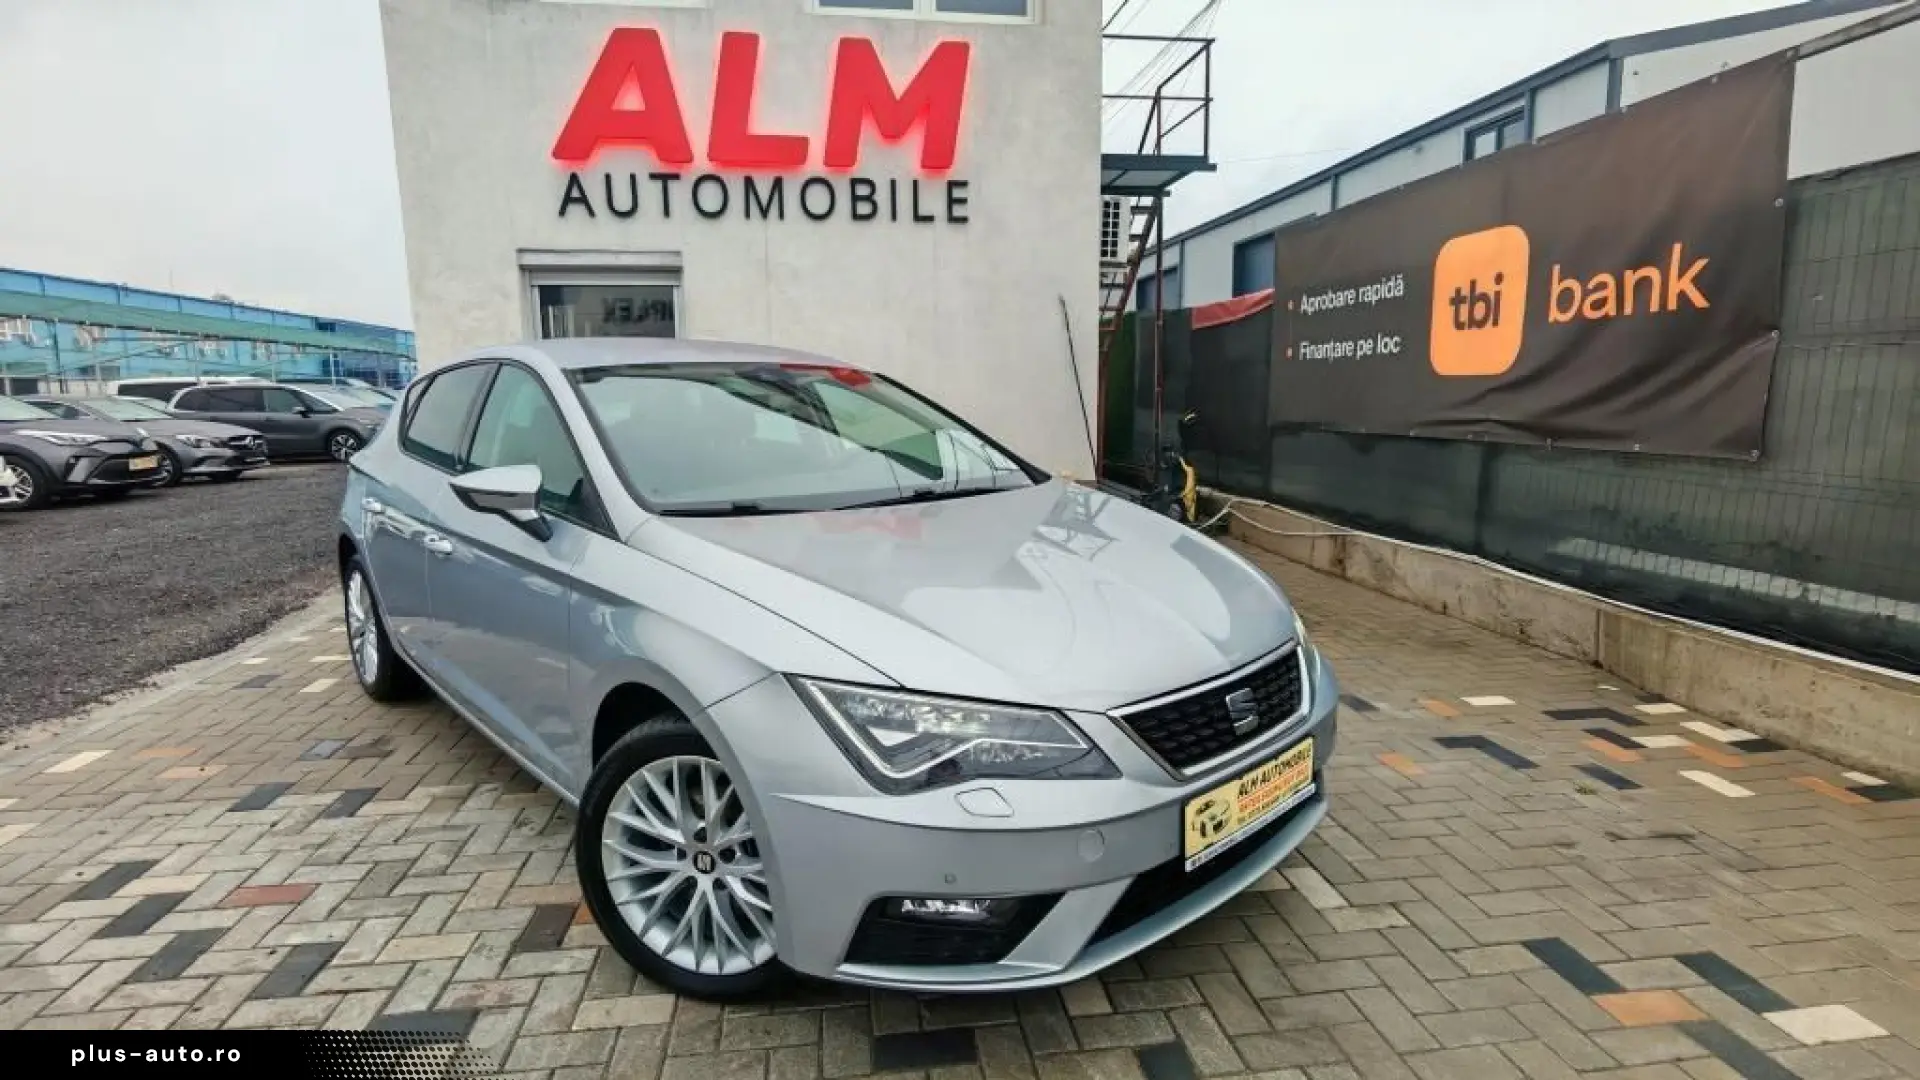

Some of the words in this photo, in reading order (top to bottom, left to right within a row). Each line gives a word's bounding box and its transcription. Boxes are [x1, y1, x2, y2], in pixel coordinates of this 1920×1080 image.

[551, 27, 971, 169] ALM
[558, 172, 970, 224] AUTOMOBILE
[1300, 290, 1356, 315] Aprobare
[1359, 273, 1404, 305] rapidă
[1449, 271, 1504, 331] tbi
[1547, 241, 1710, 325] bank
[1299, 340, 1354, 364] Finanțare
[1356, 338, 1374, 360] pe
[1377, 332, 1401, 354] loc
